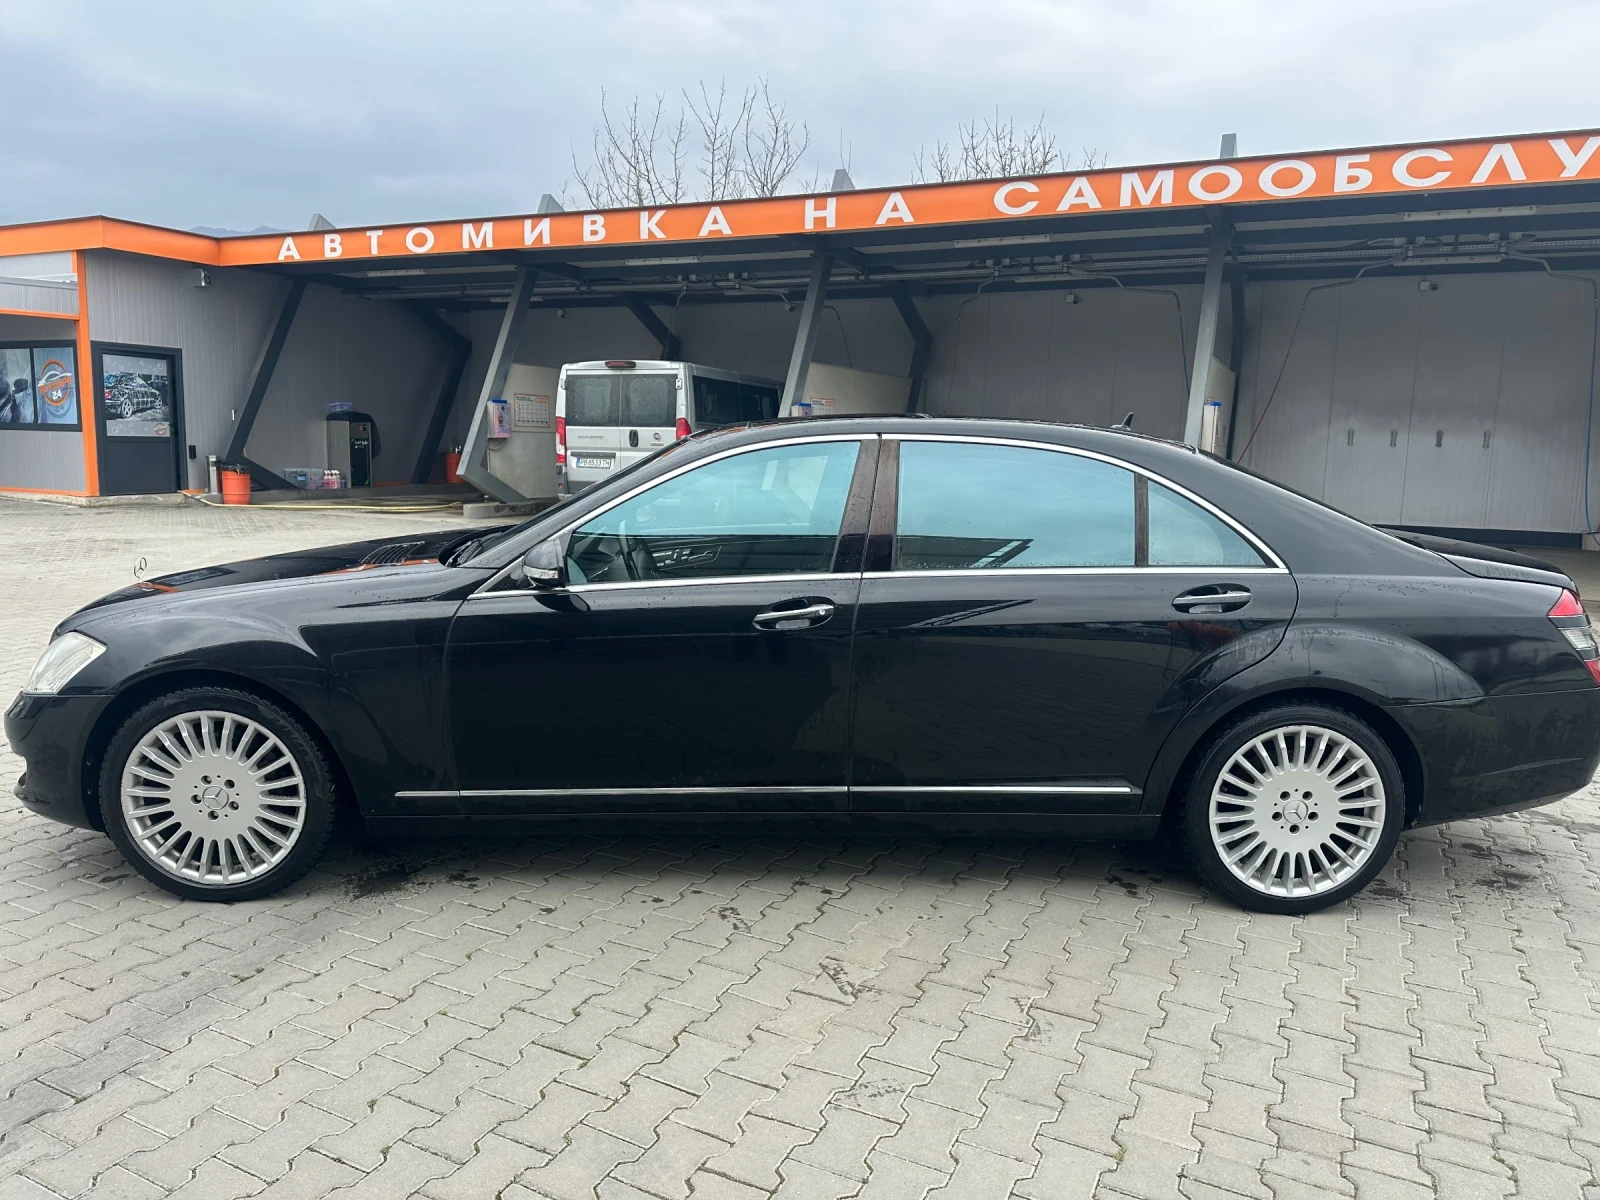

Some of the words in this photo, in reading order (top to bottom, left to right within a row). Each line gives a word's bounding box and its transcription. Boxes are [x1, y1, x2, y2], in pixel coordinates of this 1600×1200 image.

[277, 206, 733, 261] АВТОМИВКА
[804, 192, 915, 230] НА
[993, 136, 1600, 215] САМООБСЛУ
